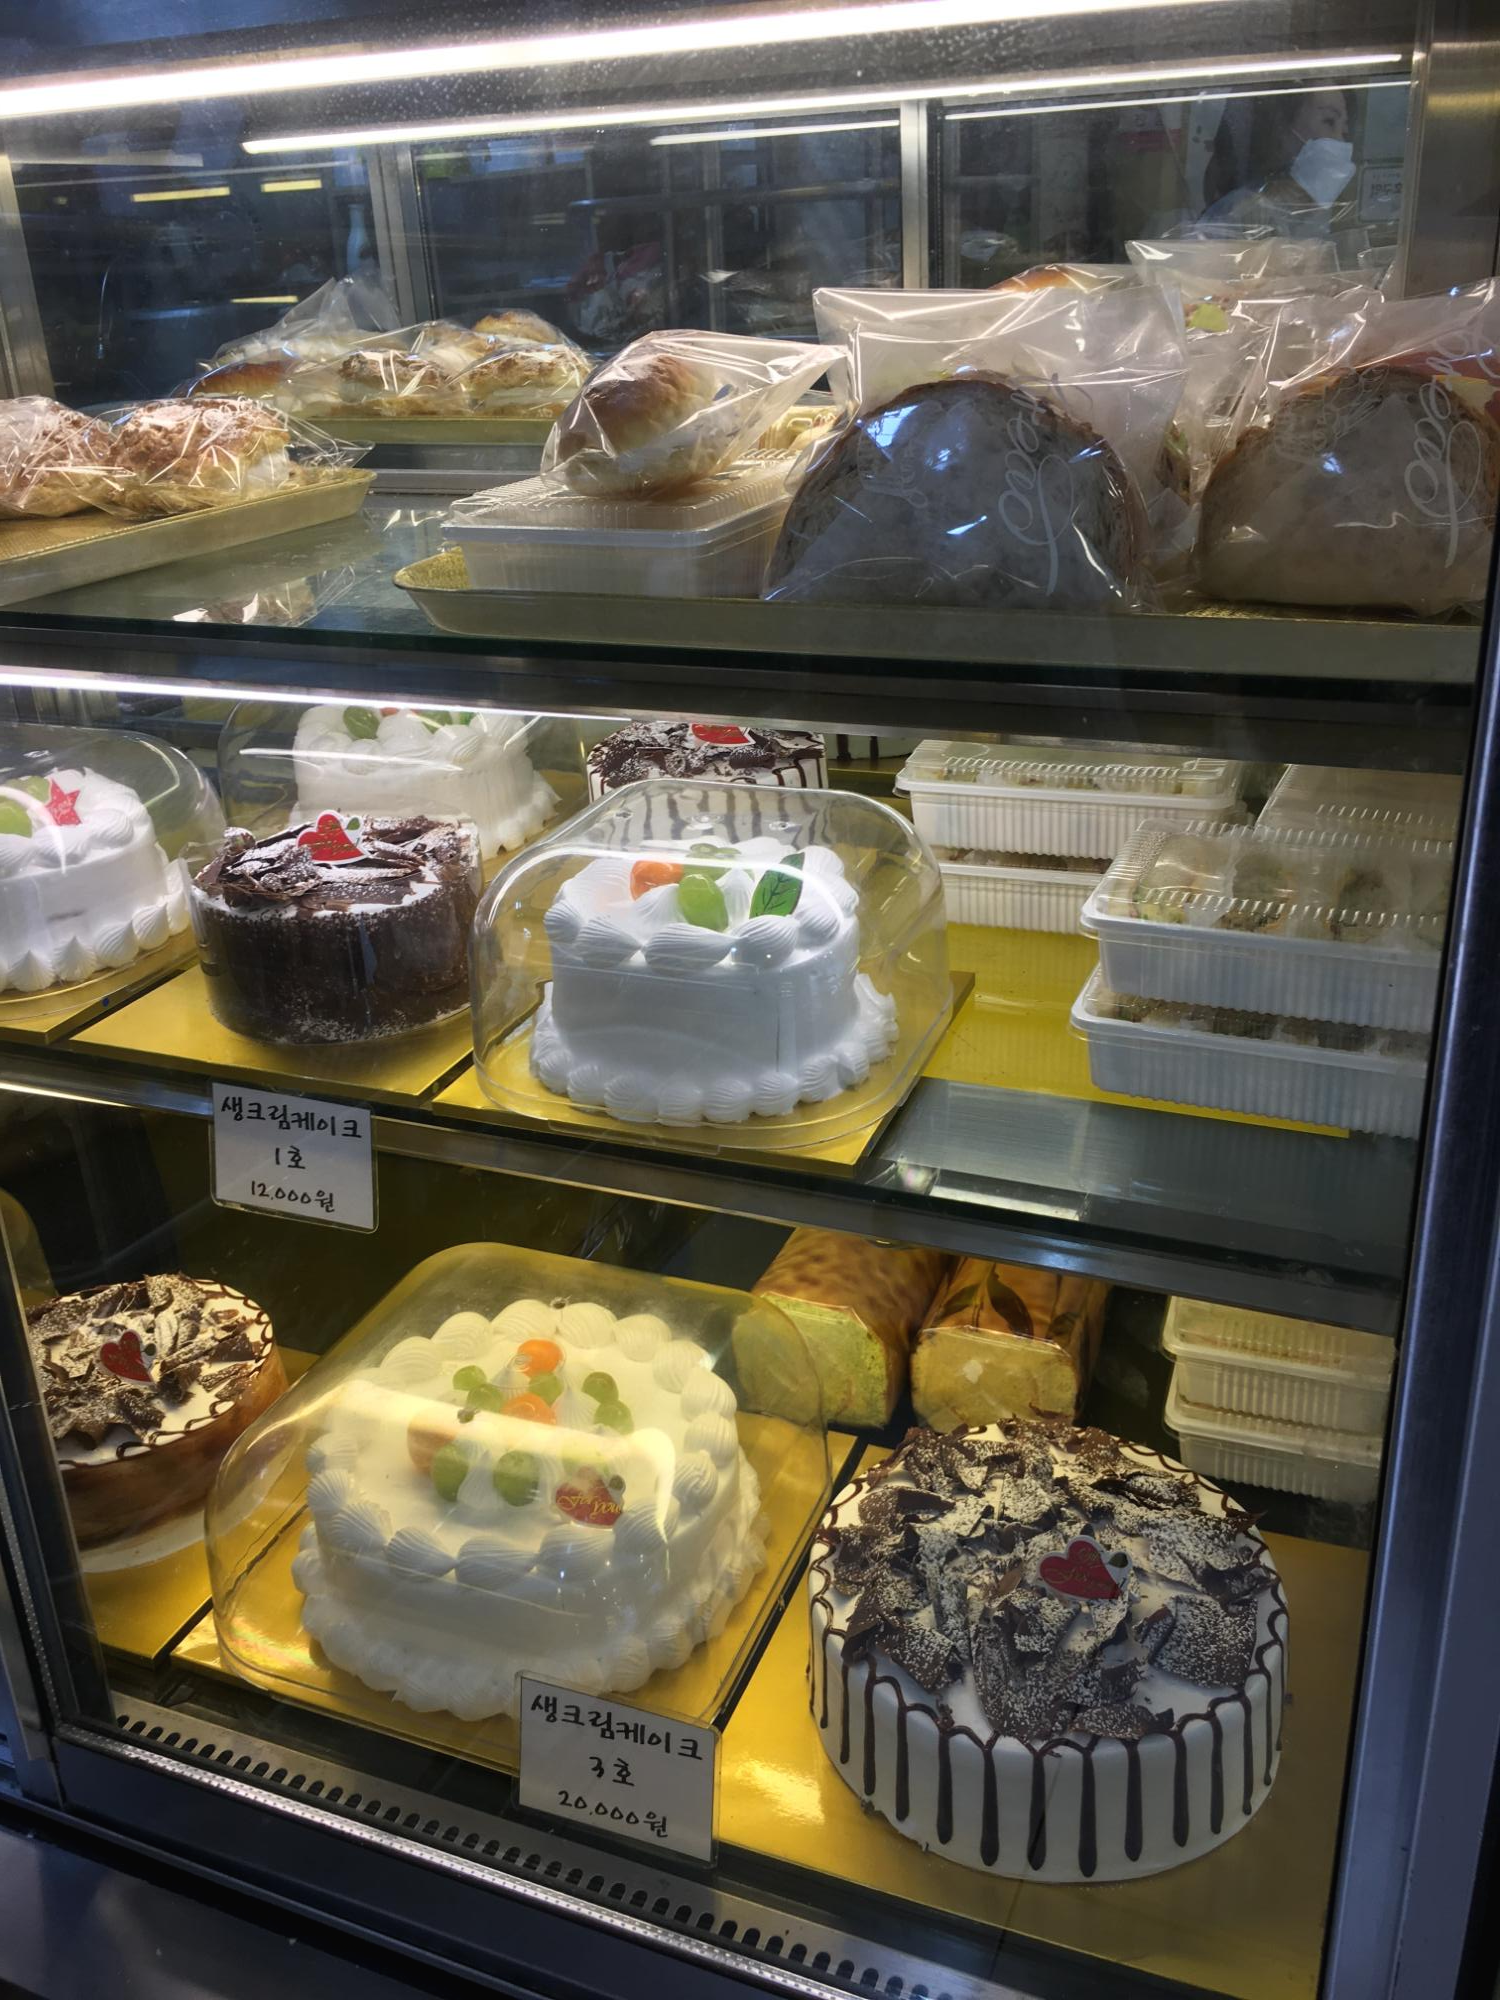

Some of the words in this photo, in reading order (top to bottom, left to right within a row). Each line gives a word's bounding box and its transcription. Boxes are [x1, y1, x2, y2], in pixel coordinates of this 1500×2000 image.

[220, 1096, 362, 1138] 생크림케이크
[275, 1145, 306, 1169] 1호
[530, 1694, 703, 1760] 생크림케이크
[589, 1756, 635, 1786] 3호
